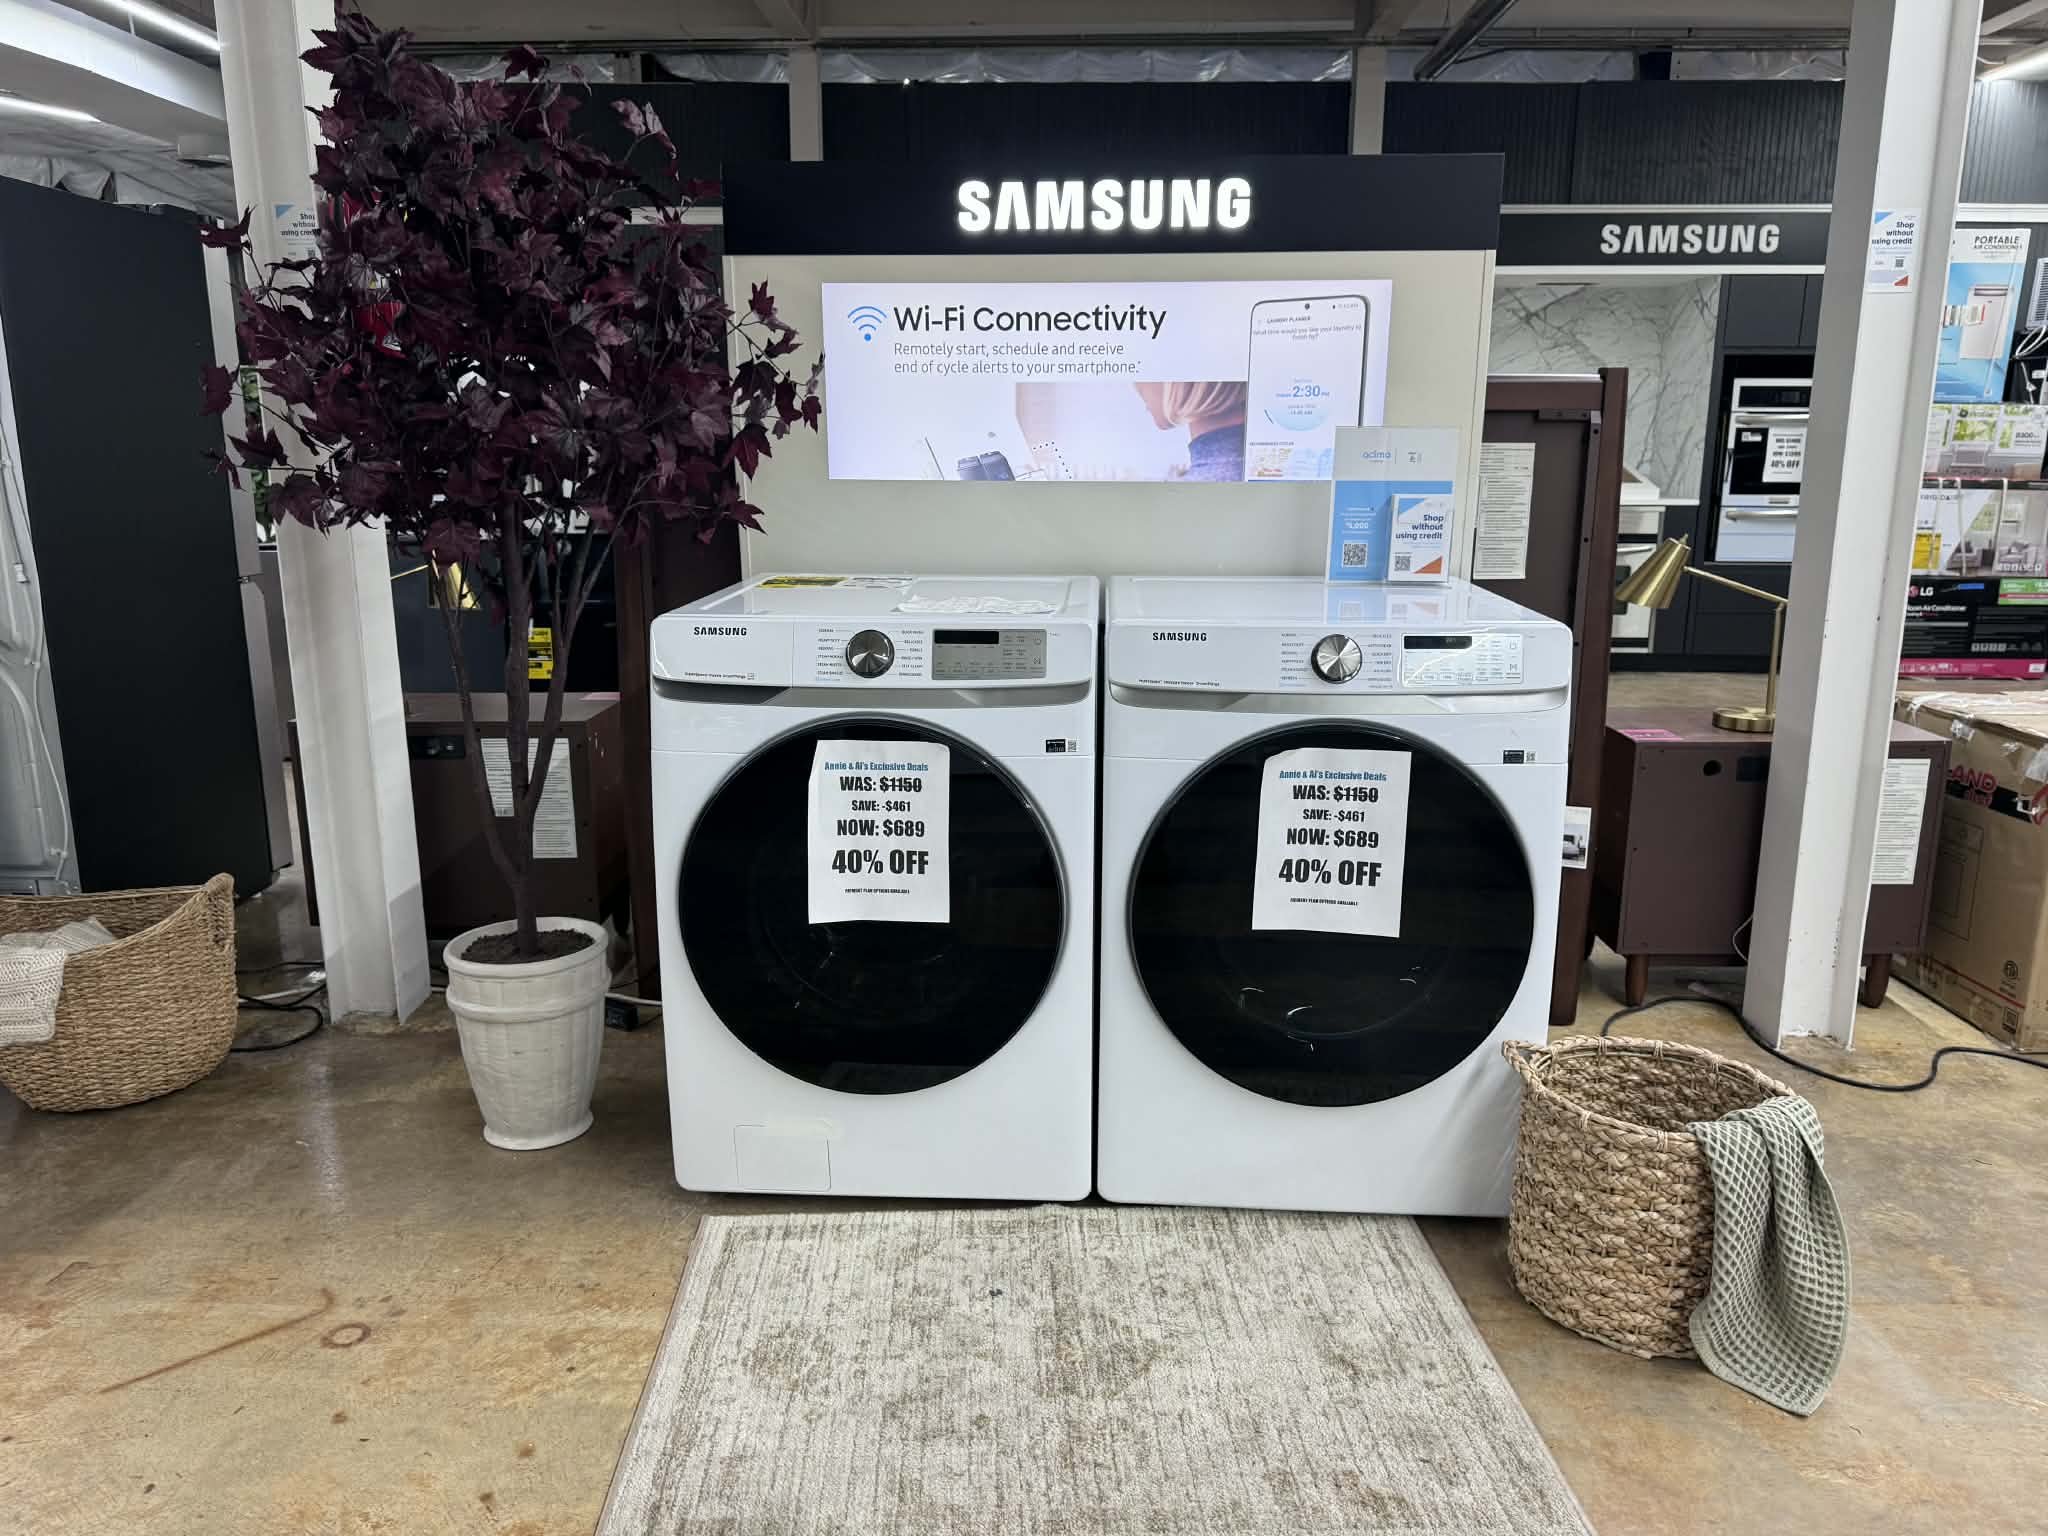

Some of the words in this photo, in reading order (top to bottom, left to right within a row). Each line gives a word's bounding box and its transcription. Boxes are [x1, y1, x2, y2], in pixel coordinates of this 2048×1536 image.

[957, 178, 1251, 232] SAMSUNG
[1896, 221, 1915, 230] Shop
[1599, 223, 1780, 254] SAMSUNG
[1886, 229, 1914, 237] without
[1892, 237, 1913, 245] credit
[1974, 235, 2021, 245] PORTABLE
[893, 304, 965, 332] Wi-Fi
[972, 303, 1167, 340] Connectivity
[894, 342, 954, 358] Remotely
[956, 343, 990, 358] start,
[992, 342, 1049, 356] schedule
[1051, 342, 1075, 356] and
[1079, 343, 1124, 356] receive
[894, 360, 918, 374] end
[920, 360, 934, 374] of
[936, 360, 969, 377] cycle
[972, 360, 1009, 374] alerts
[1012, 361, 1024, 374] to
[1027, 362, 1055, 377] your
[1293, 385, 1321, 398] 2:30
[1423, 514, 1445, 524] Shop
[1411, 523, 1444, 531] without
[1395, 532, 1417, 542] using
[1418, 532, 1442, 540] credit
[1920, 586, 1934, 597] LG
[693, 626, 747, 636] SAMSUNG
[1152, 632, 1207, 642] SAMSUNG
[824, 761, 847, 771] Annie
[848, 762, 855, 771] &
[870, 762, 906, 771] Exclusive
[1279, 770, 1301, 779] Annie
[1324, 770, 1362, 780] Exclusive
[1363, 771, 1387, 781] Deals
[840, 776, 877, 792] WAS:
[879, 775, 922, 793] $1150
[1292, 784, 1330, 801] WAS:
[1333, 785, 1379, 803] $1150
[851, 800, 880, 812] SAVE:
[881, 800, 911, 812] -$461
[1302, 808, 1332, 821] SAVE:
[1333, 810, 1365, 823] -$461
[837, 819, 880, 837] NOW:
[882, 818, 925, 838] $689
[1286, 828, 1330, 846] NOW:
[1333, 828, 1379, 849] $689
[831, 849, 884, 874] 40%
[889, 849, 929, 875] OFF
[1278, 858, 1332, 885] 40%
[1338, 859, 1383, 887] OFF
